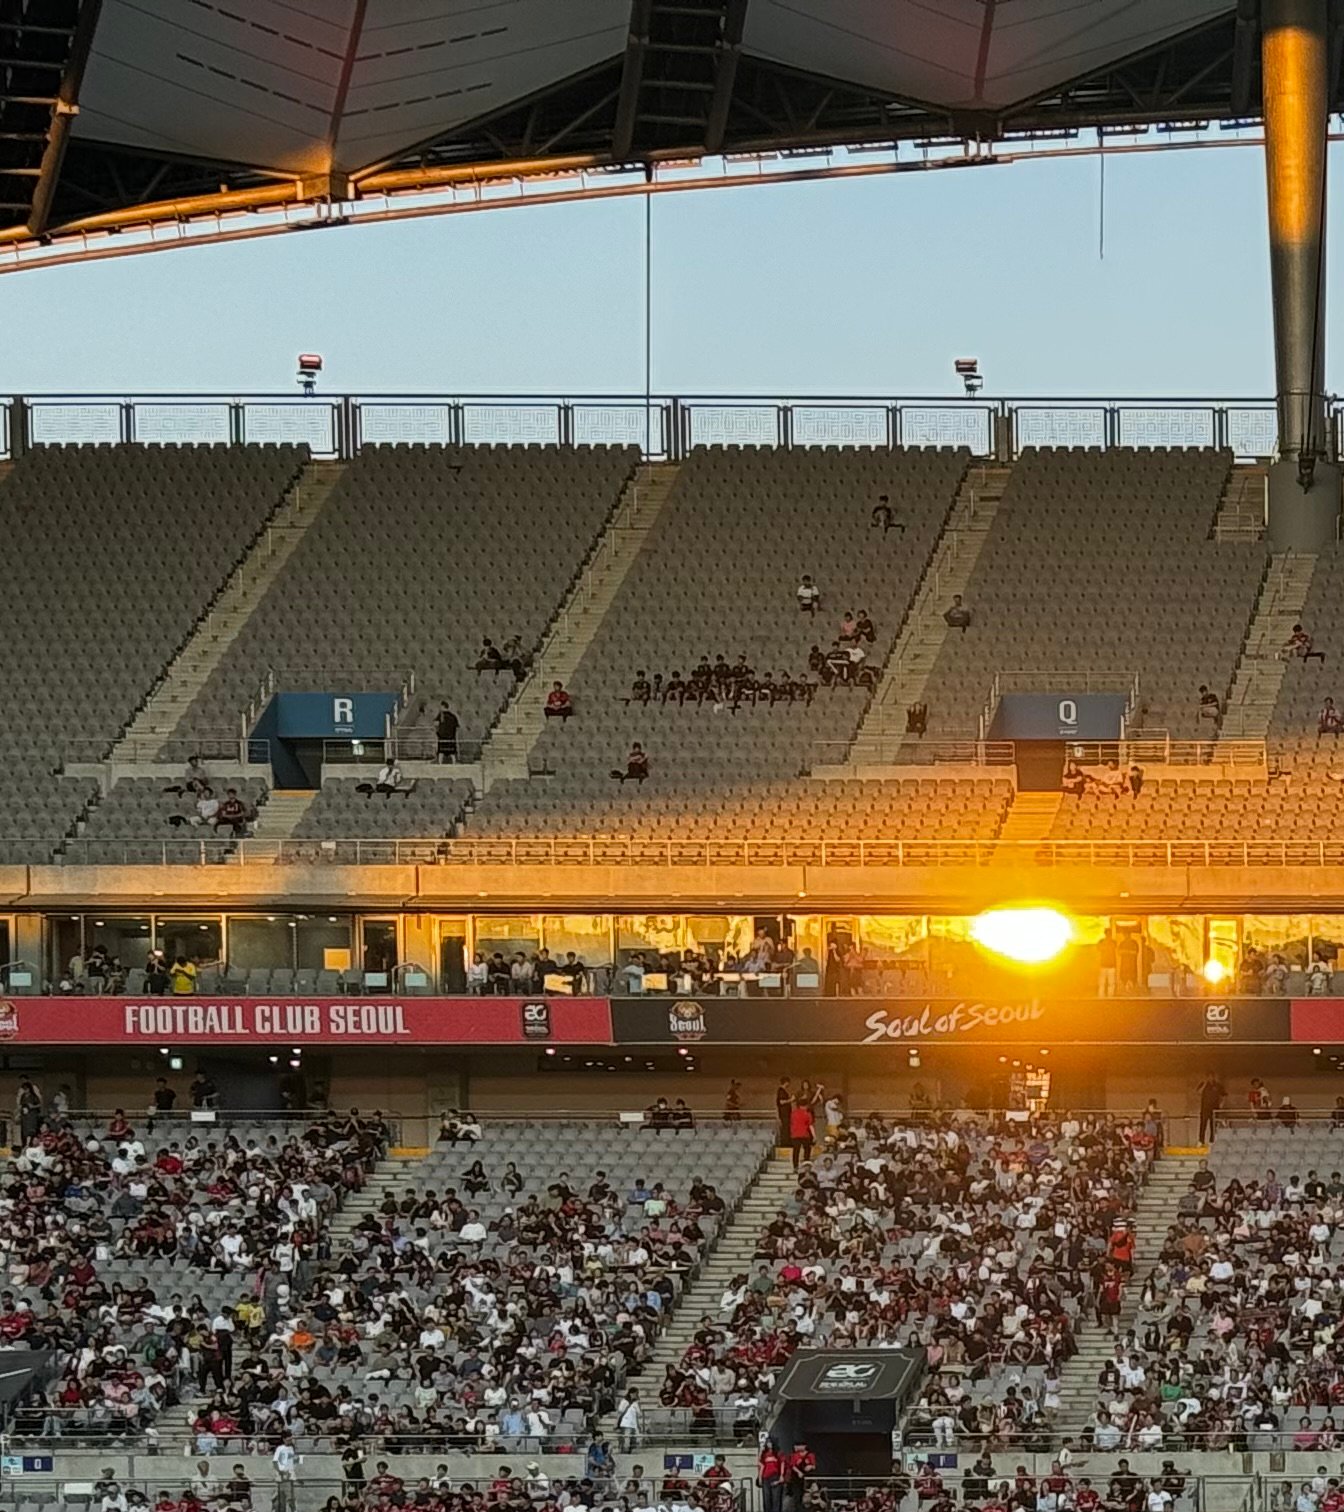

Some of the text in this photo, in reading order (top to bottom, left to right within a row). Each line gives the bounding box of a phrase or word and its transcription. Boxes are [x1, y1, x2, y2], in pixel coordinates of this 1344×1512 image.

[334, 698, 353, 722] R
[1059, 700, 1077, 725] Q
[125, 1005, 410, 1034] FOOTBALL CLUB SEOUL
